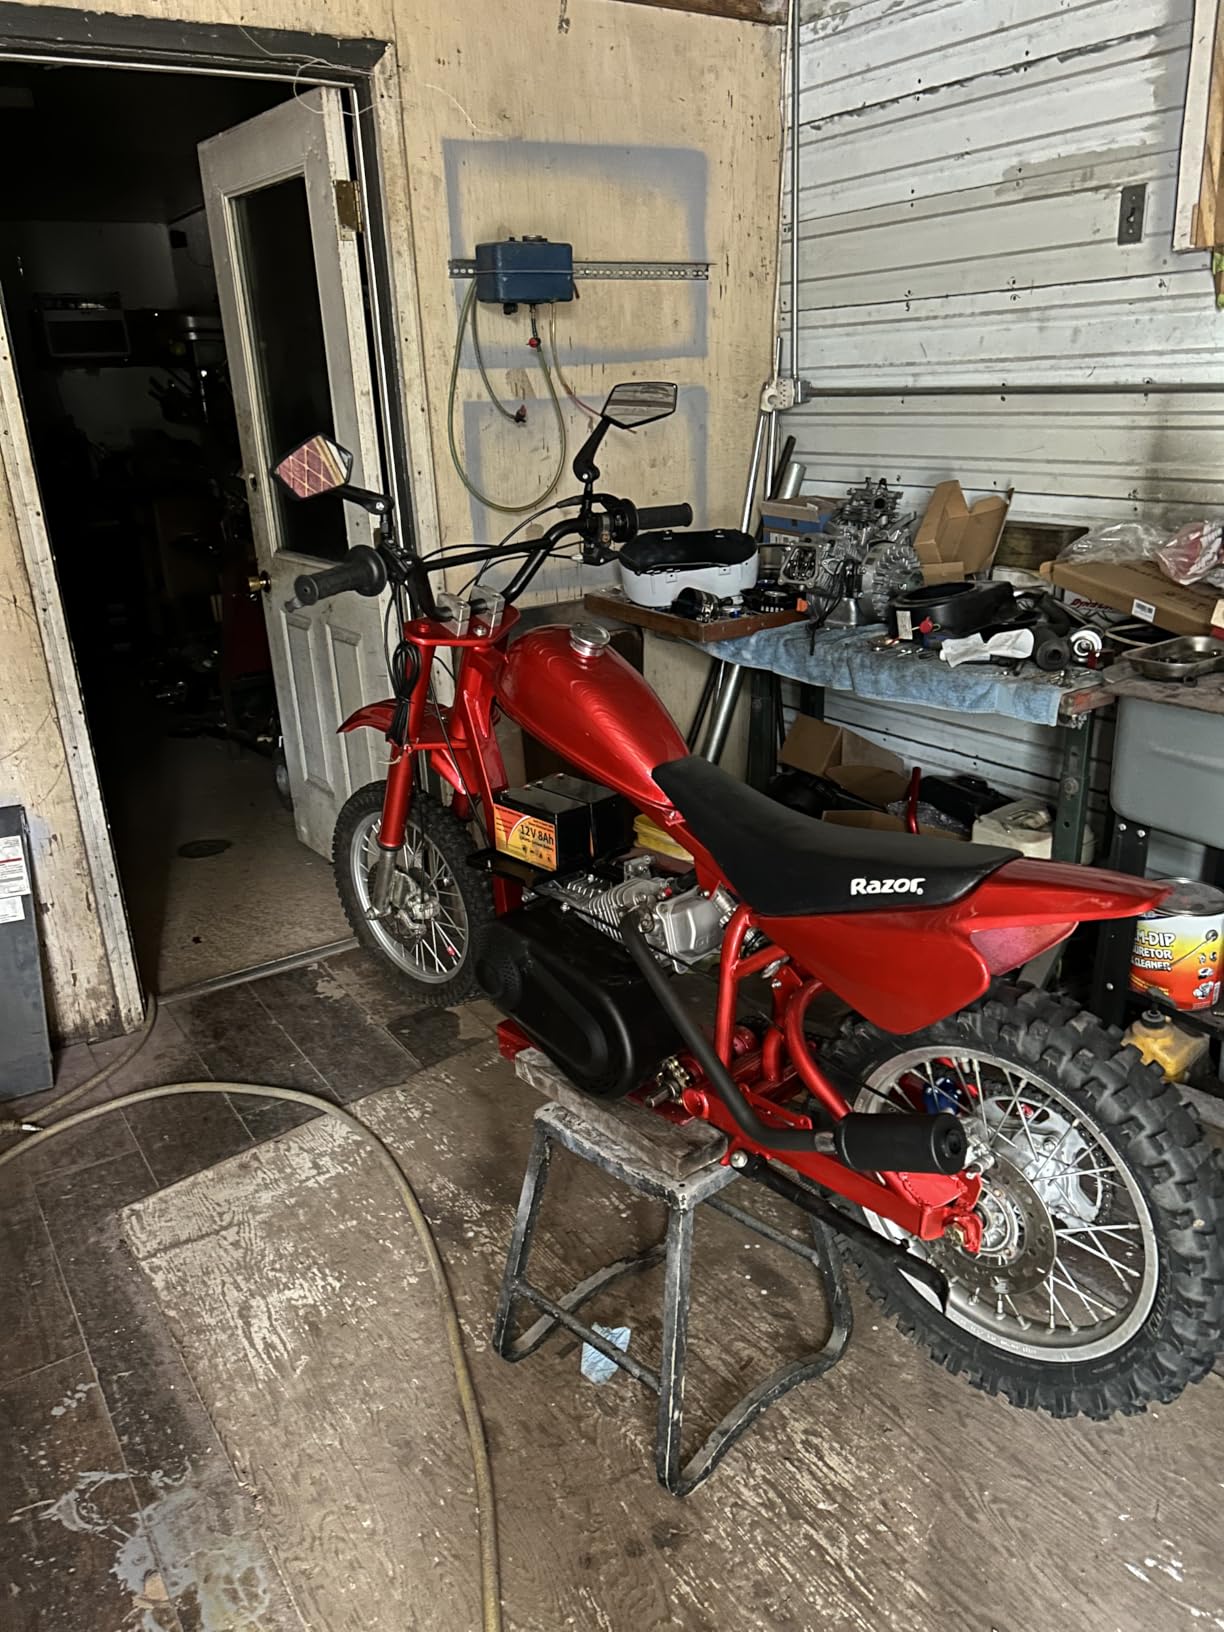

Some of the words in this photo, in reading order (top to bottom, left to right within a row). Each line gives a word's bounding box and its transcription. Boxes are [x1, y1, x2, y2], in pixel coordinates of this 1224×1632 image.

[520, 825, 536, 838] 12V
[538, 831, 554, 845] 8Ah
[1135, 929, 1176, 947] M-DIP
[1133, 945, 1173, 960] URETOR
